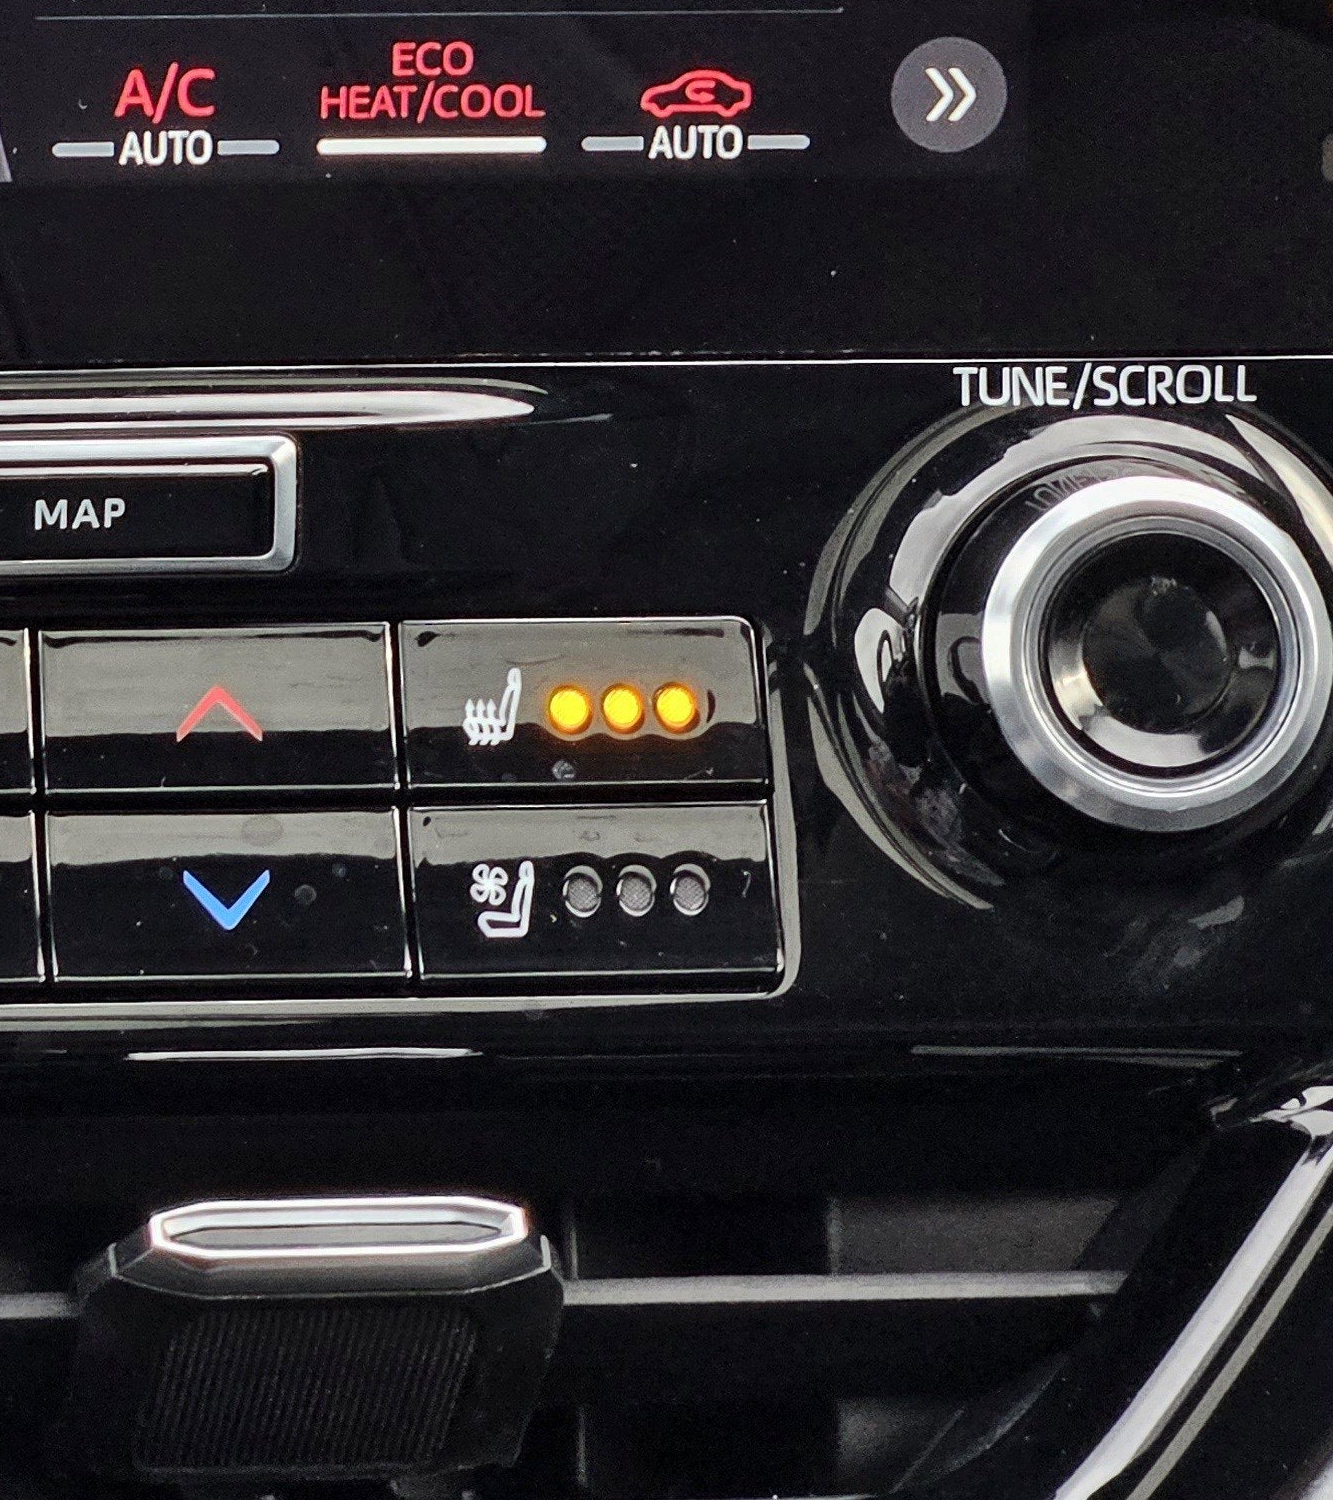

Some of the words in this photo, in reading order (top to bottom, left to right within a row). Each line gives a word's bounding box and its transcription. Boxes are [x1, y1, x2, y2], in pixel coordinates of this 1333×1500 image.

[392, 41, 475, 77] ECO
[114, 62, 216, 122] A/C
[320, 80, 546, 124] HEAT/COOL
[118, 129, 214, 167] AUTO
[648, 124, 745, 161] AUTO
[953, 363, 1257, 410] TUNE/SCROLL
[34, 497, 127, 531] MAP
